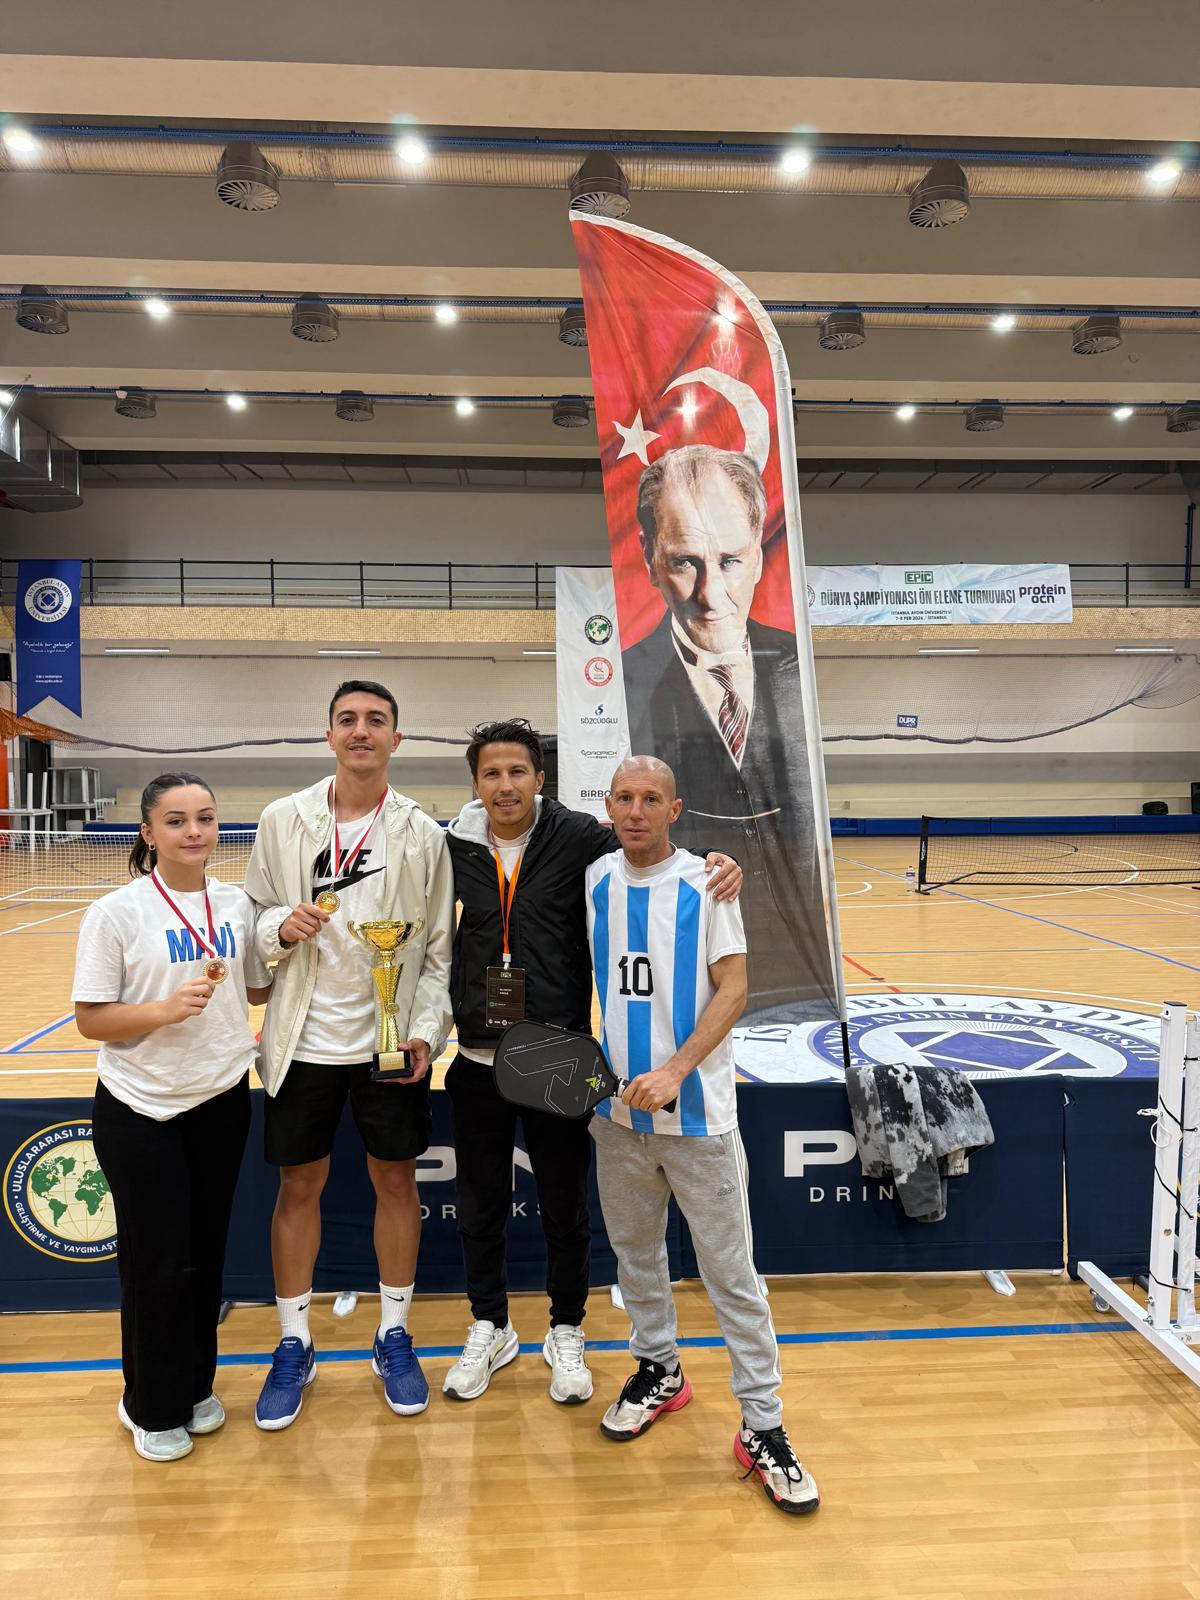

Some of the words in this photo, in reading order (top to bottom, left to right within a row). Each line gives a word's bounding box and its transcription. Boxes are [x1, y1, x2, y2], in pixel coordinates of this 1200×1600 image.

[820, 588, 850, 606] DÜNYA
[852, 588, 917, 609] ŞAMPİYONASI
[918, 588, 931, 605] ÖN
[933, 590, 962, 605] ELEME
[963, 589, 1016, 604] TURNUVASI
[1018, 584, 1066, 598] protein
[1031, 595, 1055, 604] ocn
[618, 955, 654, 997] 10
[986, 1000, 1161, 1031] AYDI
[12, 1129, 73, 1192] ULUSLARARASI
[15, 1201, 48, 1242] GELİŞTİRME
[49, 1238, 61, 1249] VE
